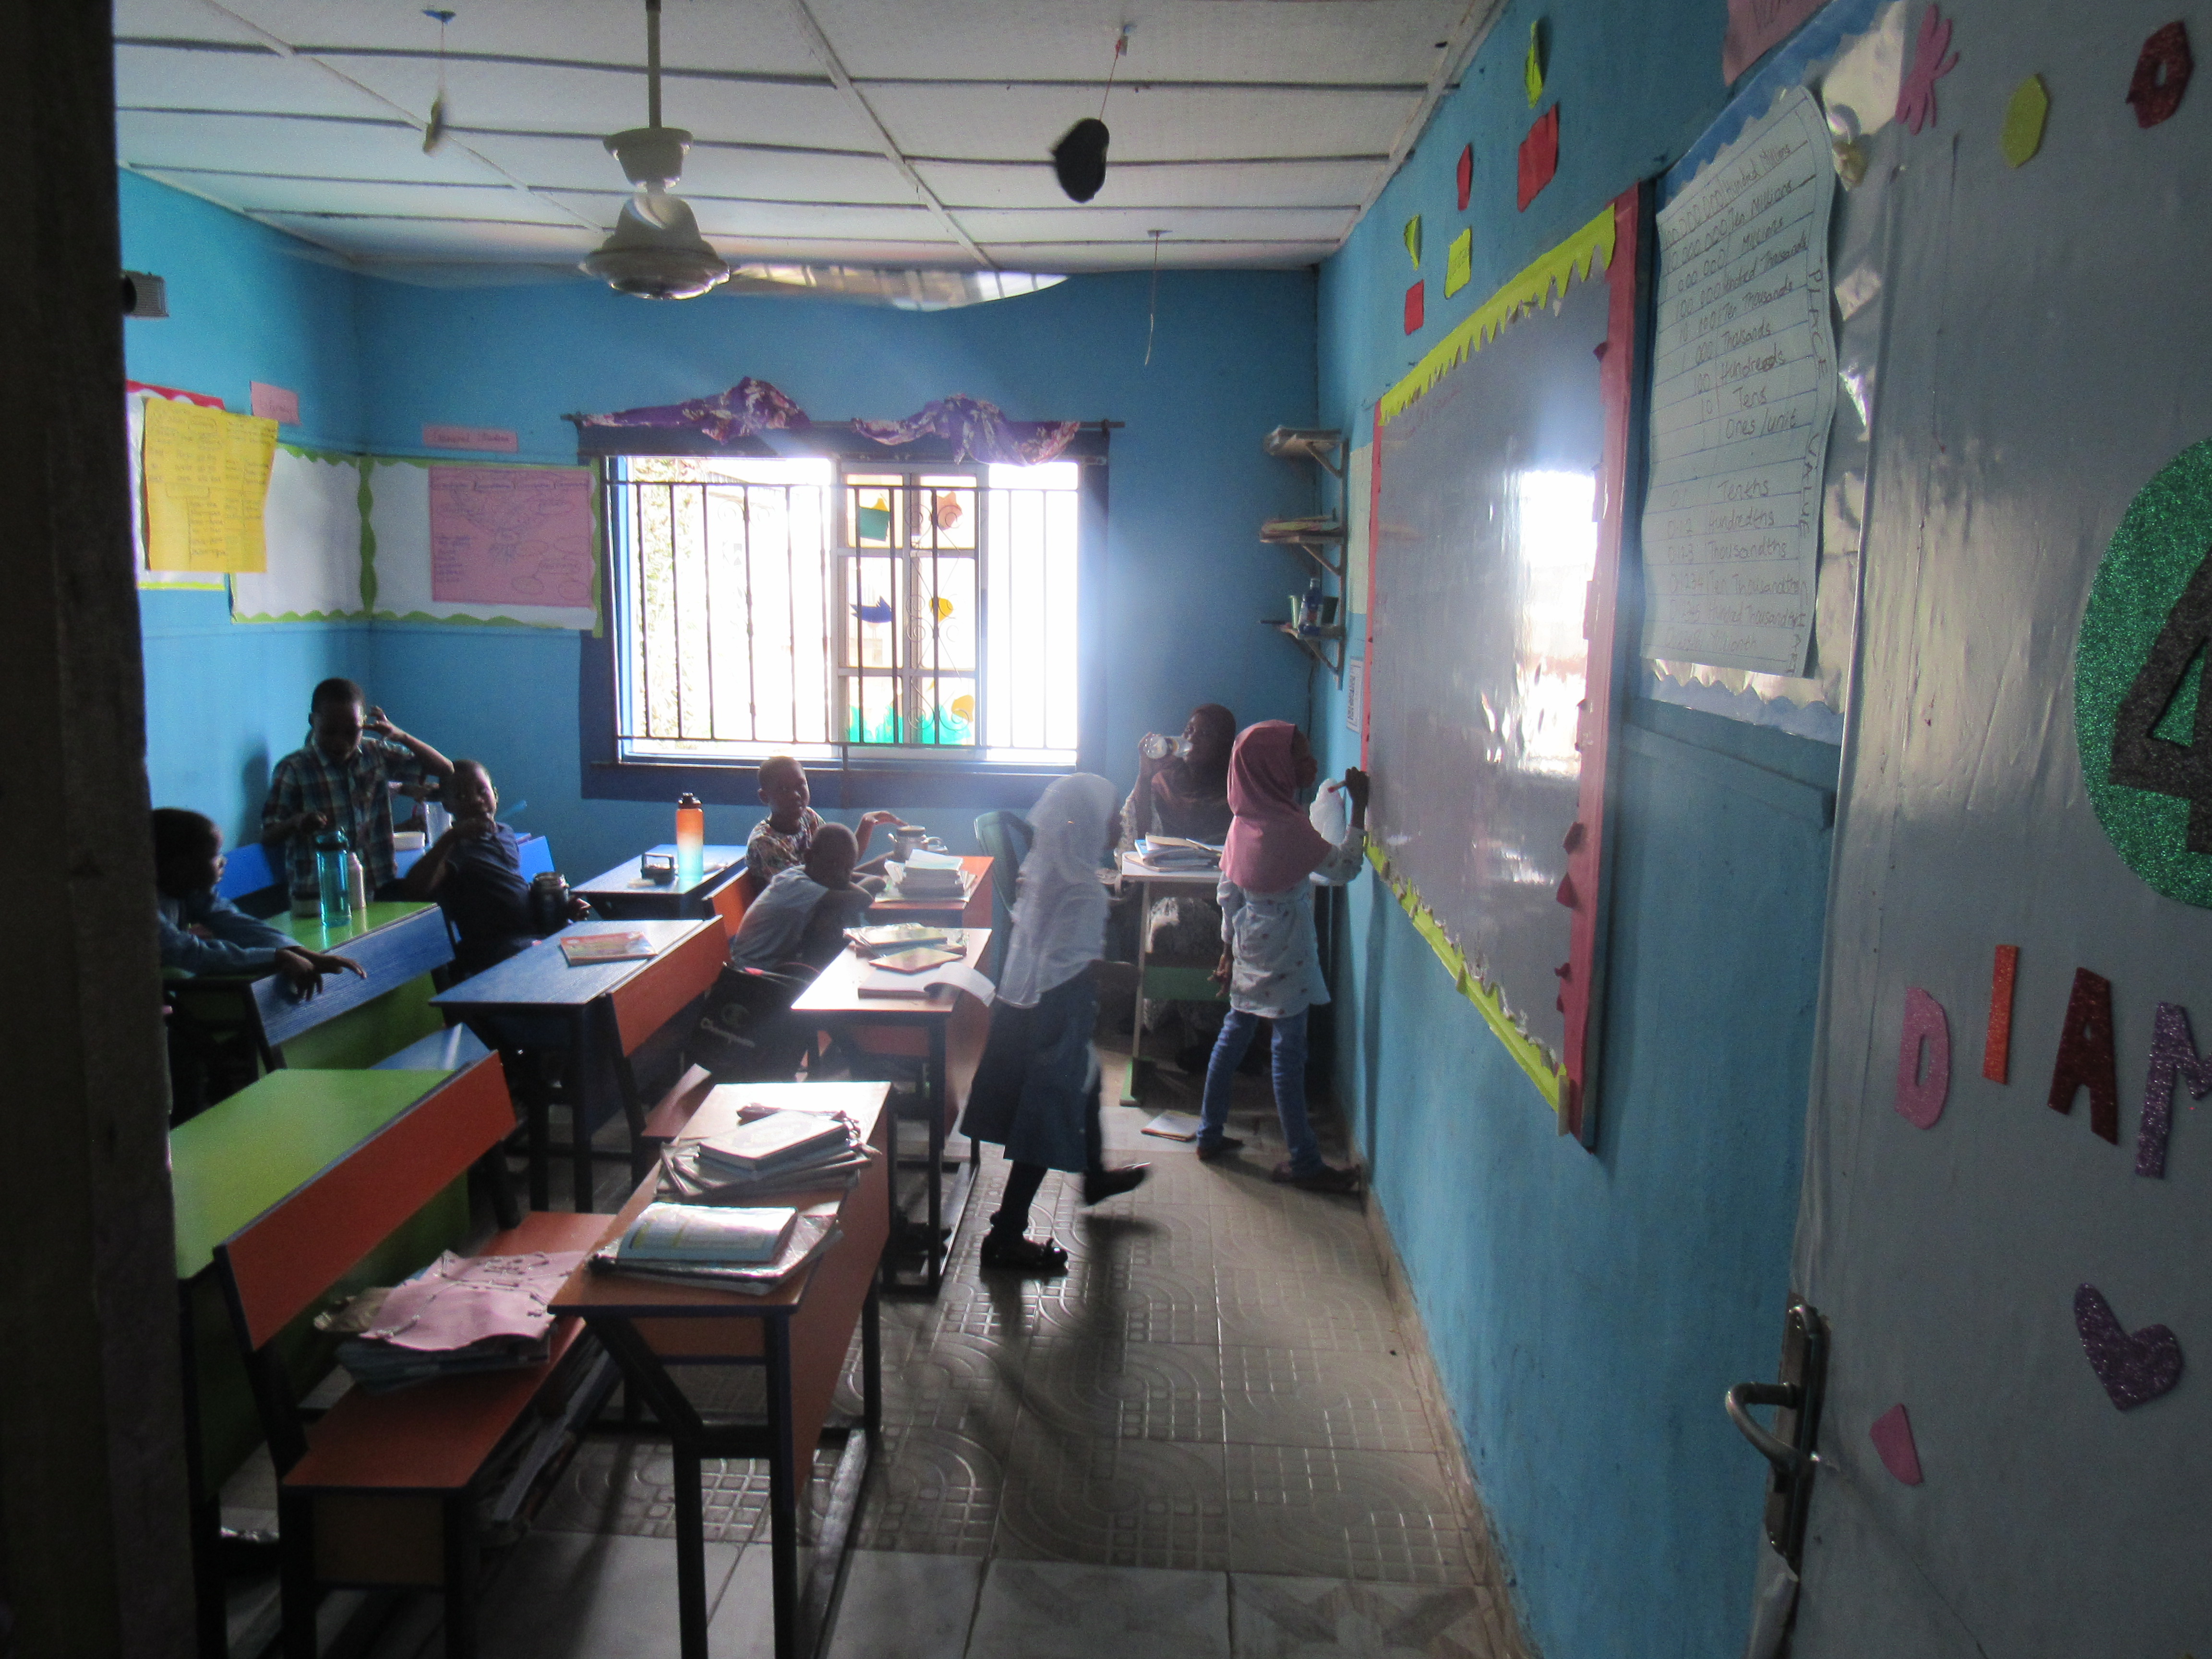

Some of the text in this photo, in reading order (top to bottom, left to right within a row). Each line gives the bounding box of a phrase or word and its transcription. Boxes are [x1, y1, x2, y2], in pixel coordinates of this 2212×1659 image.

[1807, 268, 1828, 380] PLACE
[1732, 385, 1767, 410] Tens
[1726, 419, 1755, 440] Ones
[1718, 478, 1769, 501] Tenths
[1798, 433, 1820, 539] VALUE
[1709, 506, 1775, 533] Hundredths
[1707, 536, 1787, 560] Thousandths
[2108, 543, 2212, 854] 4
